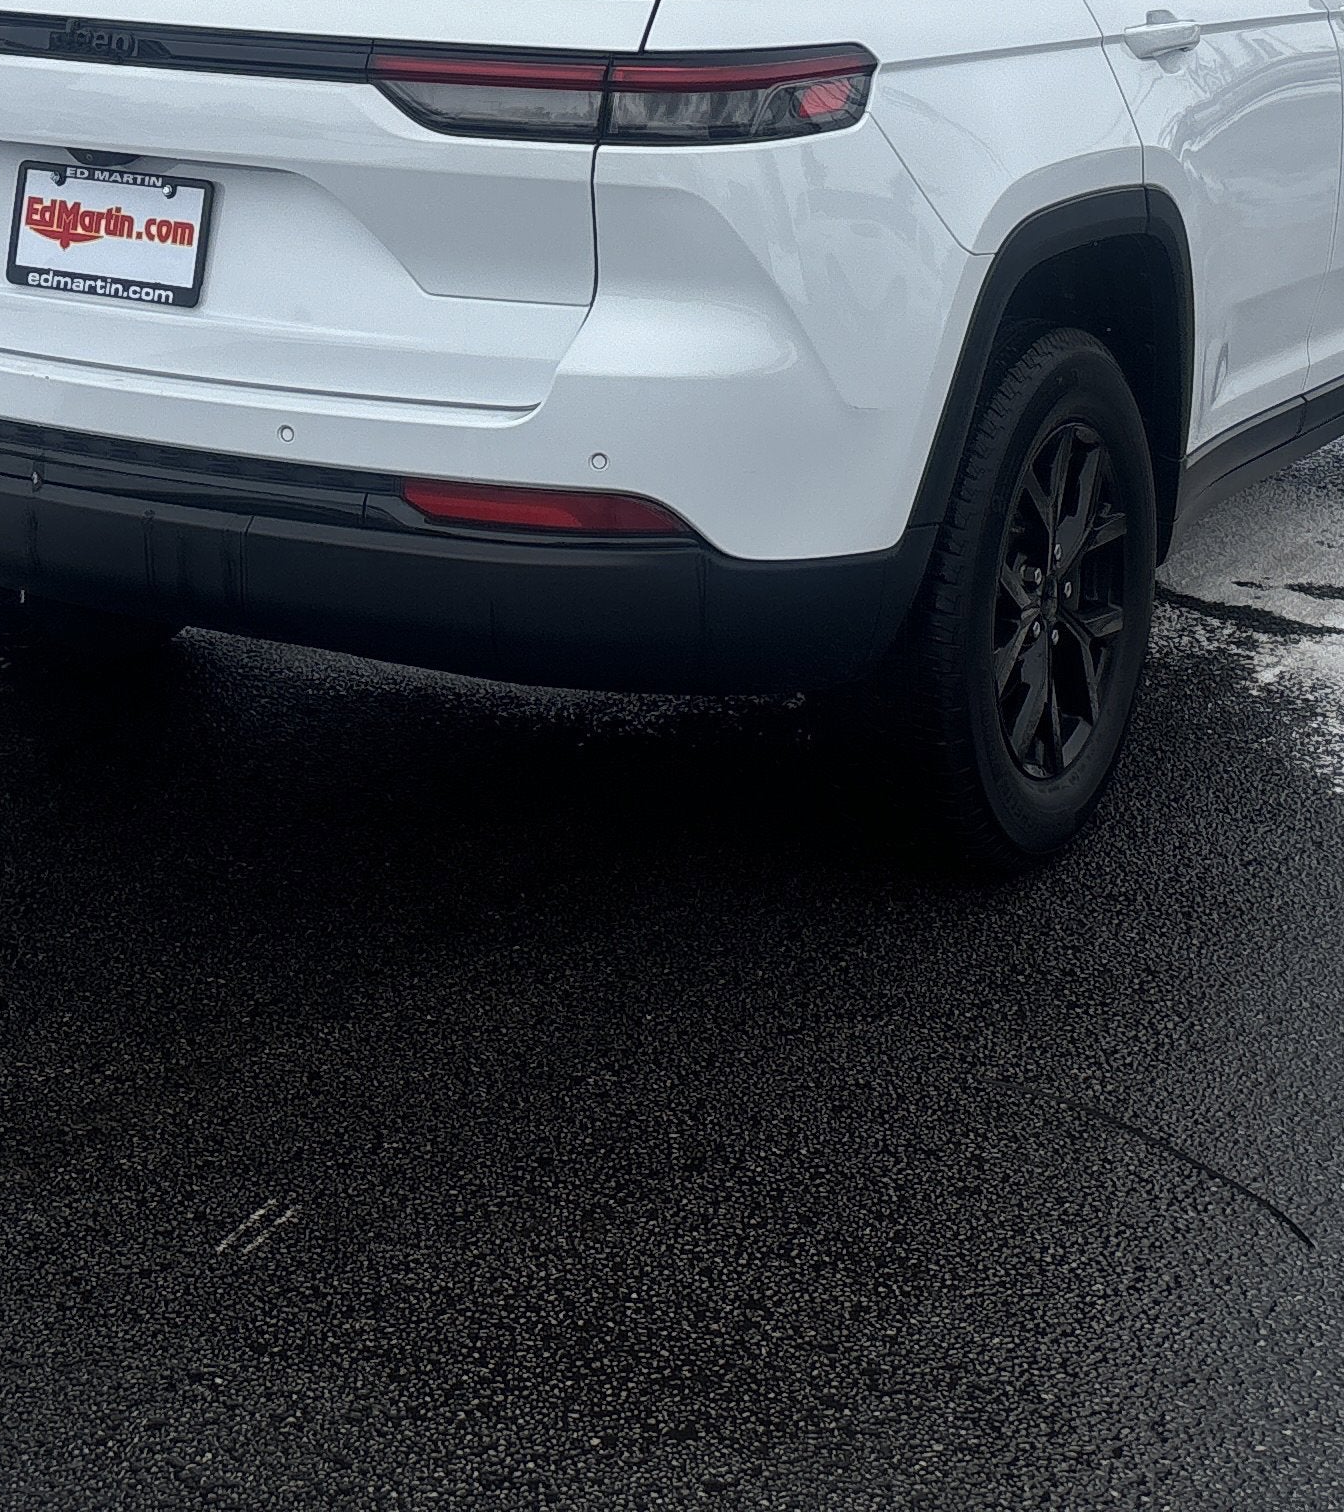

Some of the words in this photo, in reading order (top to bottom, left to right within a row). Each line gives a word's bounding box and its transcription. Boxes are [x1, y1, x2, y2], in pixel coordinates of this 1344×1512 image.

[66, 167, 89, 179] ED
[94, 170, 163, 187] MARTIN
[25, 195, 195, 248] EdMartin.com
[27, 269, 174, 304] edmartin.com
